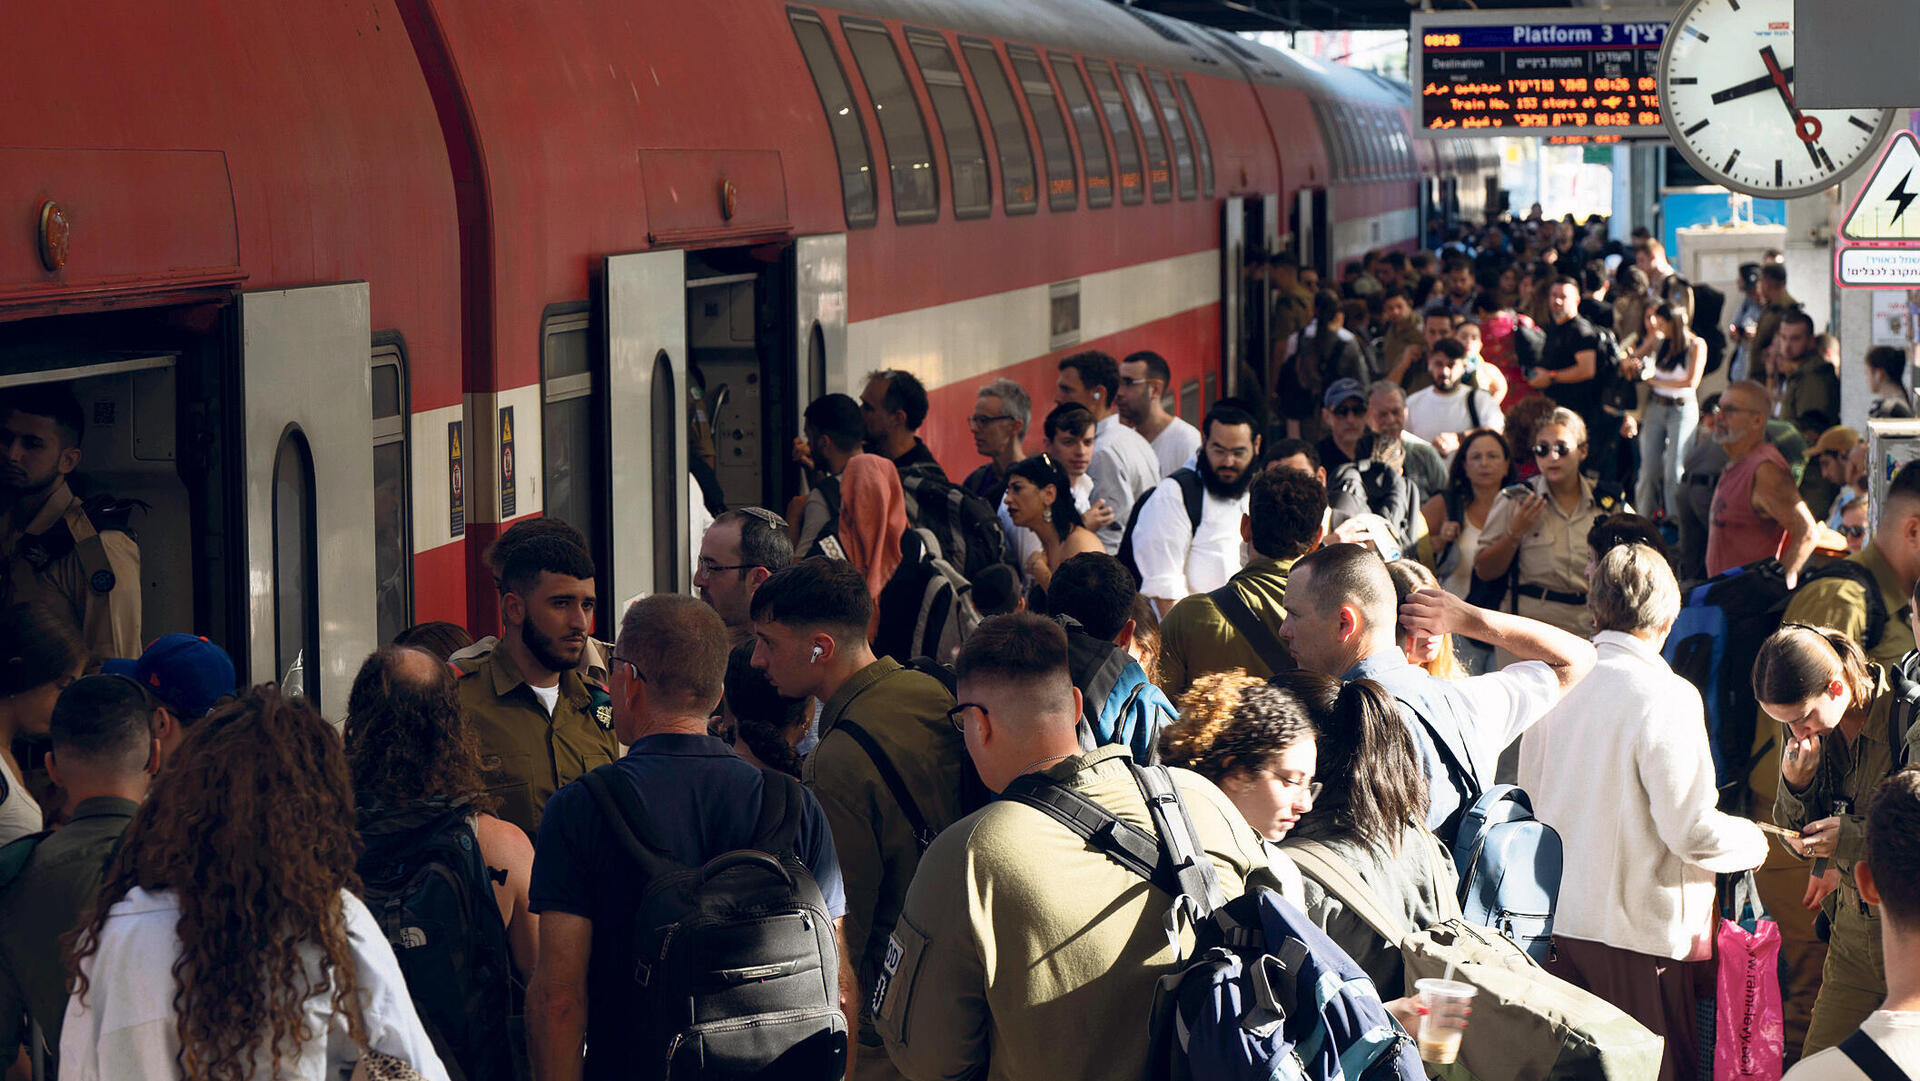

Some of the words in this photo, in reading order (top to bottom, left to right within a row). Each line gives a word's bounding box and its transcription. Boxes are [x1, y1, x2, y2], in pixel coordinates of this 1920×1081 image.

[1513, 25, 1593, 43] Platform
[1601, 24, 1614, 43] 3
[1432, 57, 1485, 70] Destination
[1450, 98, 1486, 110] Train
[1891, 268, 1920, 278] תקרב
